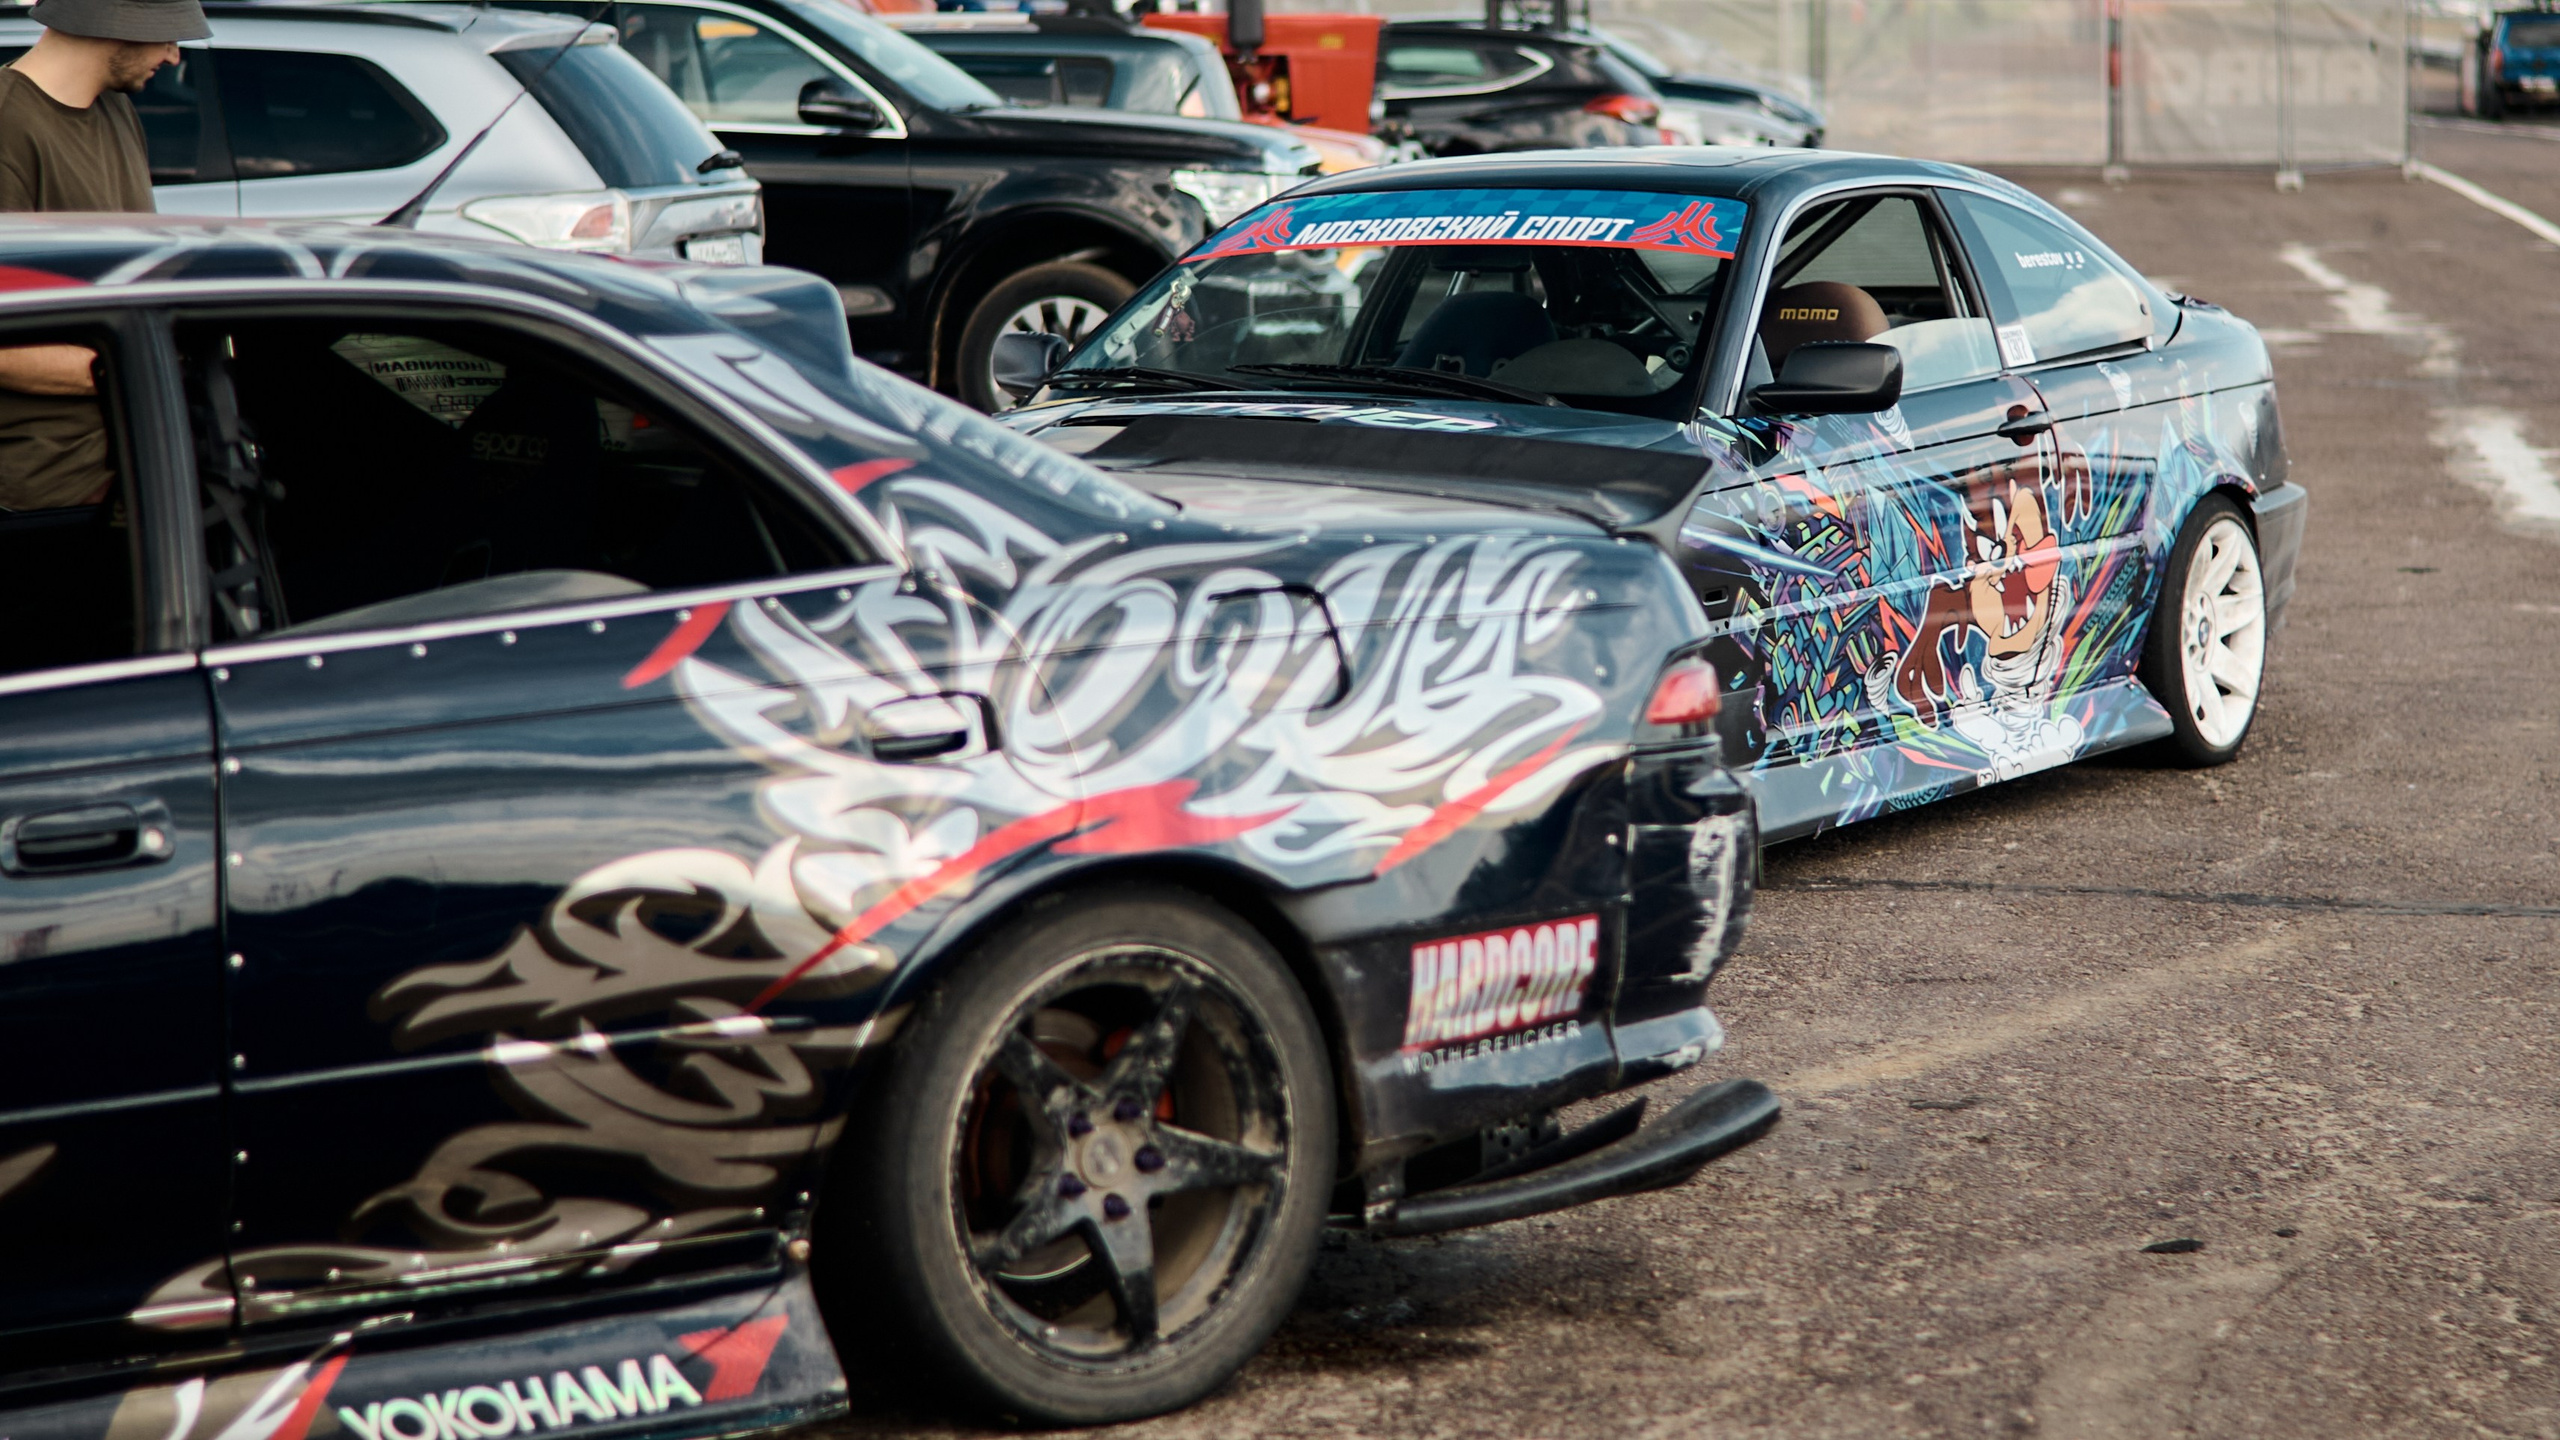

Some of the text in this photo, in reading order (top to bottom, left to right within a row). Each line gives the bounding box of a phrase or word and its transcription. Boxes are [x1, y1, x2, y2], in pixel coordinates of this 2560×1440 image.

[1292, 211, 1635, 245] МОСКОВСКИЙ СПОРТ
[1404, 918, 1599, 1046] HARDCORE
[1403, 1019, 1582, 1075] MOTHERFUCKER
[338, 1353, 703, 1440] YOKOHAMA
